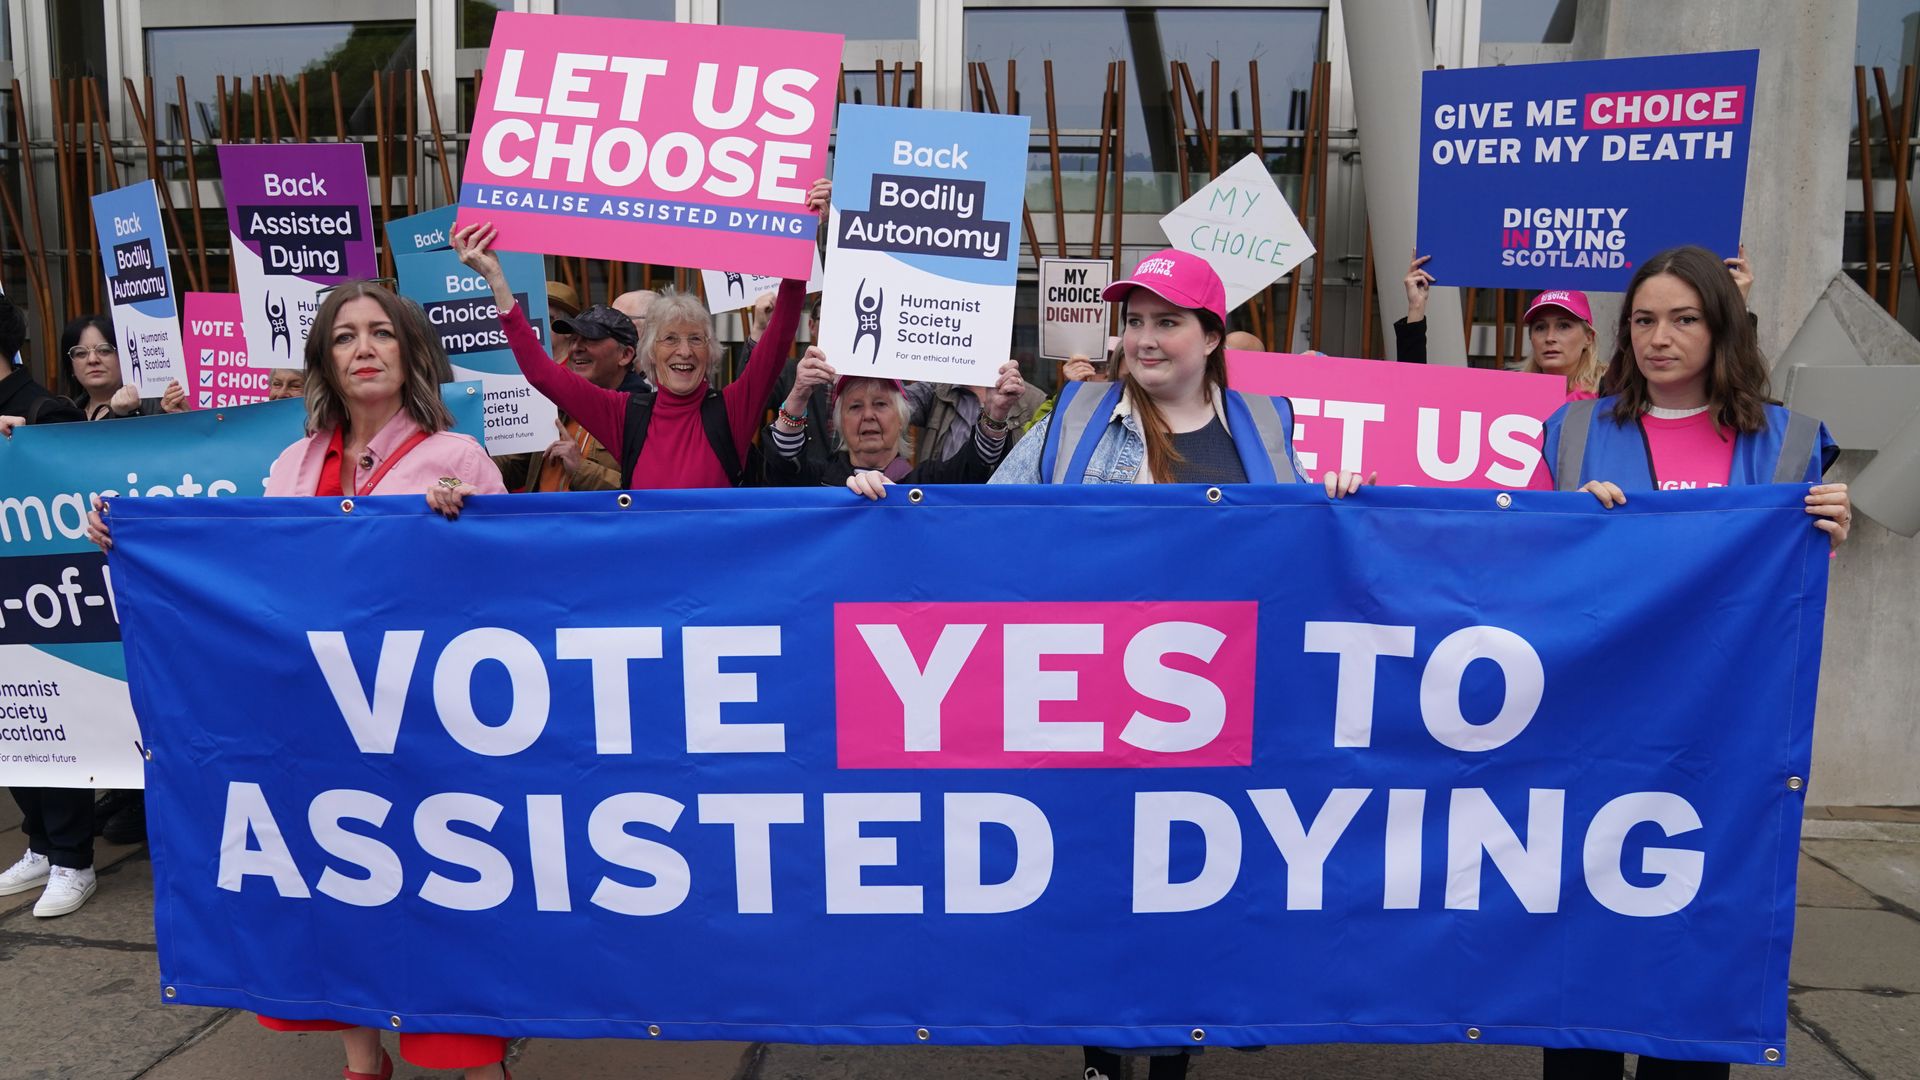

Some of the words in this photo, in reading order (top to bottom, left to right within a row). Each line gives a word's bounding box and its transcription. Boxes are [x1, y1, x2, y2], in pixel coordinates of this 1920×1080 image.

[493, 49, 668, 122] LET
[692, 62, 820, 136] US
[1434, 101, 1513, 130] GIVE
[1526, 99, 1577, 127] ME
[1590, 90, 1738, 124] CHOICE
[892, 140, 969, 170] Back
[1432, 138, 1521, 166] OVER
[1534, 135, 1591, 163] MY
[1601, 131, 1733, 162] DEATH
[481, 118, 812, 204] CHOOSE
[263, 172, 328, 197] Back
[476, 188, 590, 214] LEGALISE
[600, 199, 718, 226] ASSISTED
[728, 211, 803, 234] DYING
[879, 181, 975, 219] Bodily
[1208, 186, 1261, 218] MY
[114, 211, 142, 237] Back
[250, 211, 352, 235] Assisted
[1502, 207, 1629, 229] DIGNITY
[414, 229, 445, 248] Back
[845, 216, 1001, 258] Autonomy
[1190, 224, 1291, 267] CHOICE
[1502, 229, 1530, 249] IN
[1535, 228, 1627, 251] DYING
[117, 244, 151, 270] Bodily
[270, 245, 340, 274] Dying
[1501, 249, 1633, 269] SCOTLAND.
[114, 274, 166, 300] Autonomy
[446, 275, 491, 294] Bac
[1065, 268, 1088, 285] MY
[428, 303, 498, 325] Choice
[900, 293, 981, 313] Humanist
[898, 311, 962, 332] Society
[1046, 306, 1103, 323] DIGNITY
[140, 331, 169, 343] Humanist
[191, 320, 234, 337] VOTE
[896, 329, 973, 348] Scotland
[143, 345, 165, 358] Society
[895, 351, 909, 360] For
[911, 353, 921, 361] an
[923, 353, 950, 364] ethical
[951, 355, 976, 366] future
[145, 357, 171, 371] Scotland
[217, 371, 269, 390] CHOIC
[483, 387, 531, 401] umanist
[483, 402, 519, 415] ociety
[483, 413, 529, 428] cotland
[494, 432, 514, 441] ethical
[516, 431, 535, 439] future
[1288, 397, 1386, 475] ET
[1416, 407, 1543, 488] US
[306, 625, 787, 757] VOTE
[855, 620, 1227, 754] YES
[1304, 620, 1545, 753] TO
[0, 702, 48, 723] ociety
[24, 753, 51, 763] ethical
[52, 753, 77, 763] future
[216, 780, 1055, 917] ASSISTED
[1131, 786, 1706, 918] DYING
